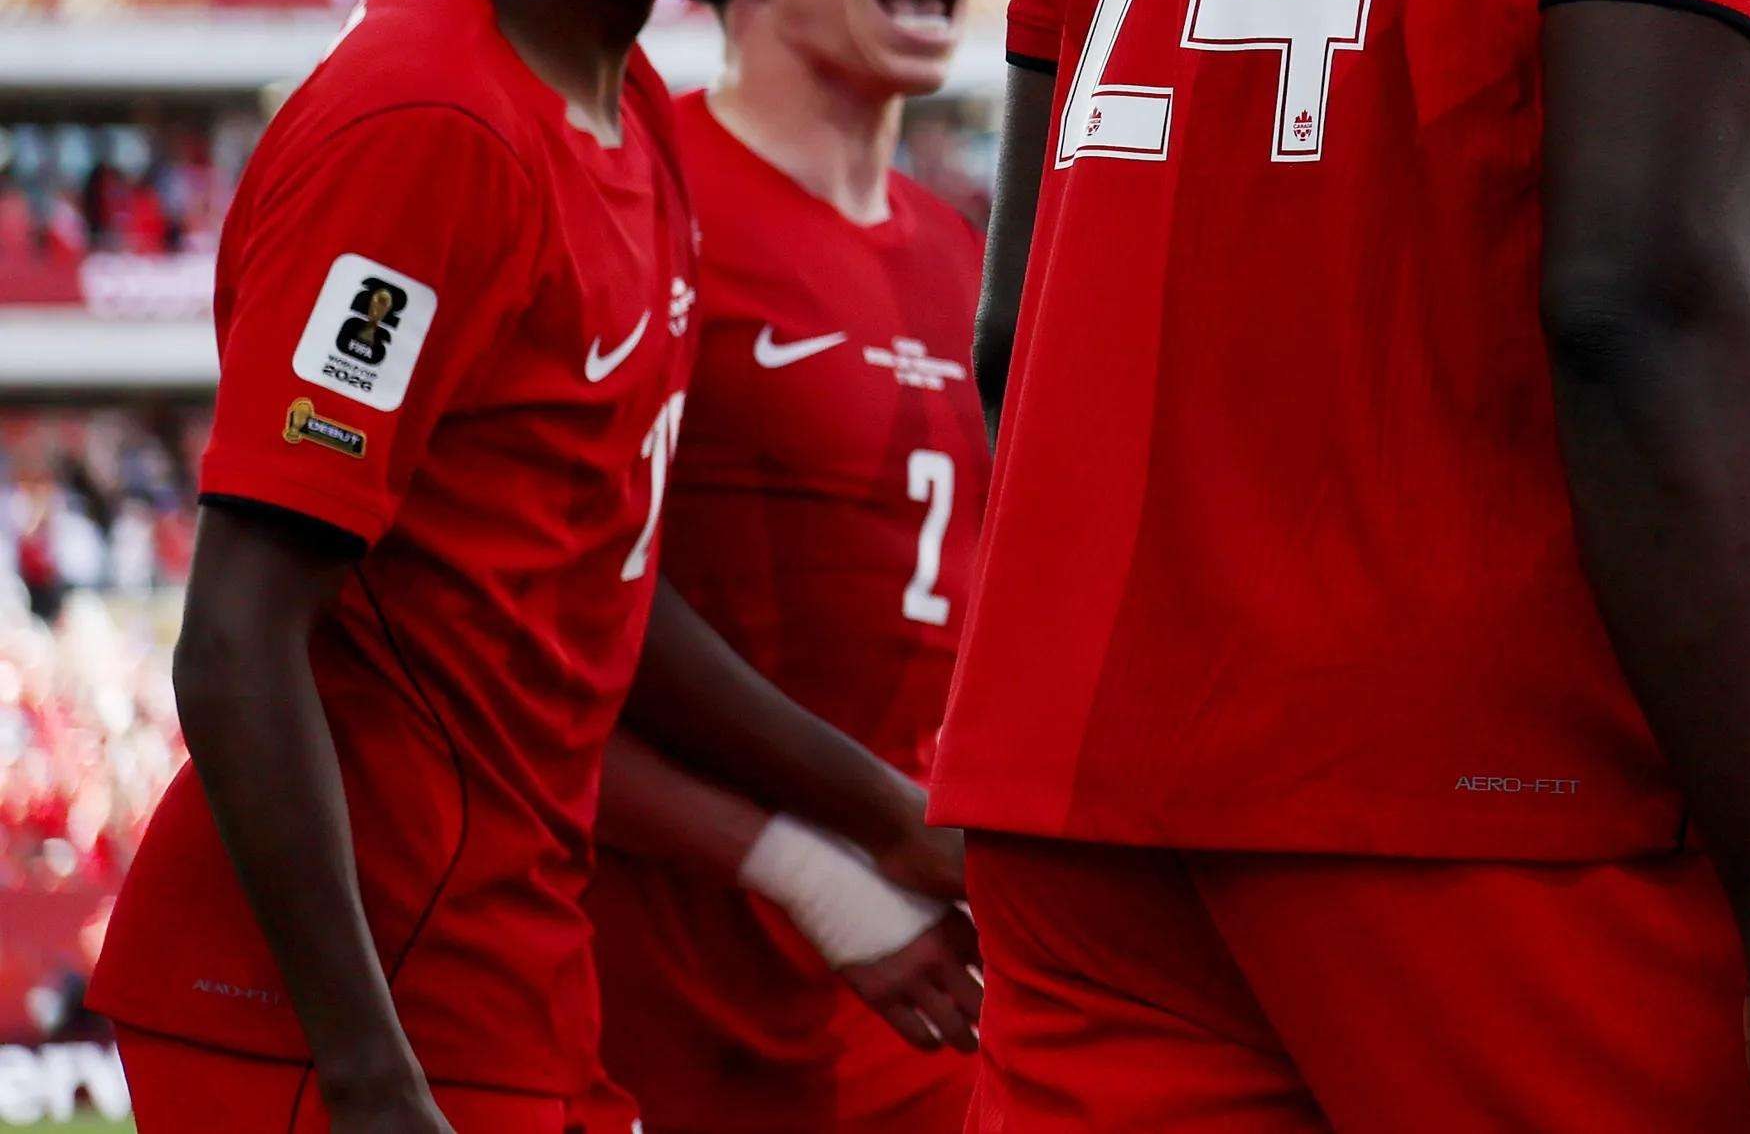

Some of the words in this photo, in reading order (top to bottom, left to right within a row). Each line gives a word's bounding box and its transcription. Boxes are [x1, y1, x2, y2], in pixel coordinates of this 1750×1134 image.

[322, 365, 373, 392] 2026
[903, 448, 955, 627] 2
[1454, 775, 1581, 794] AERO-FIT
